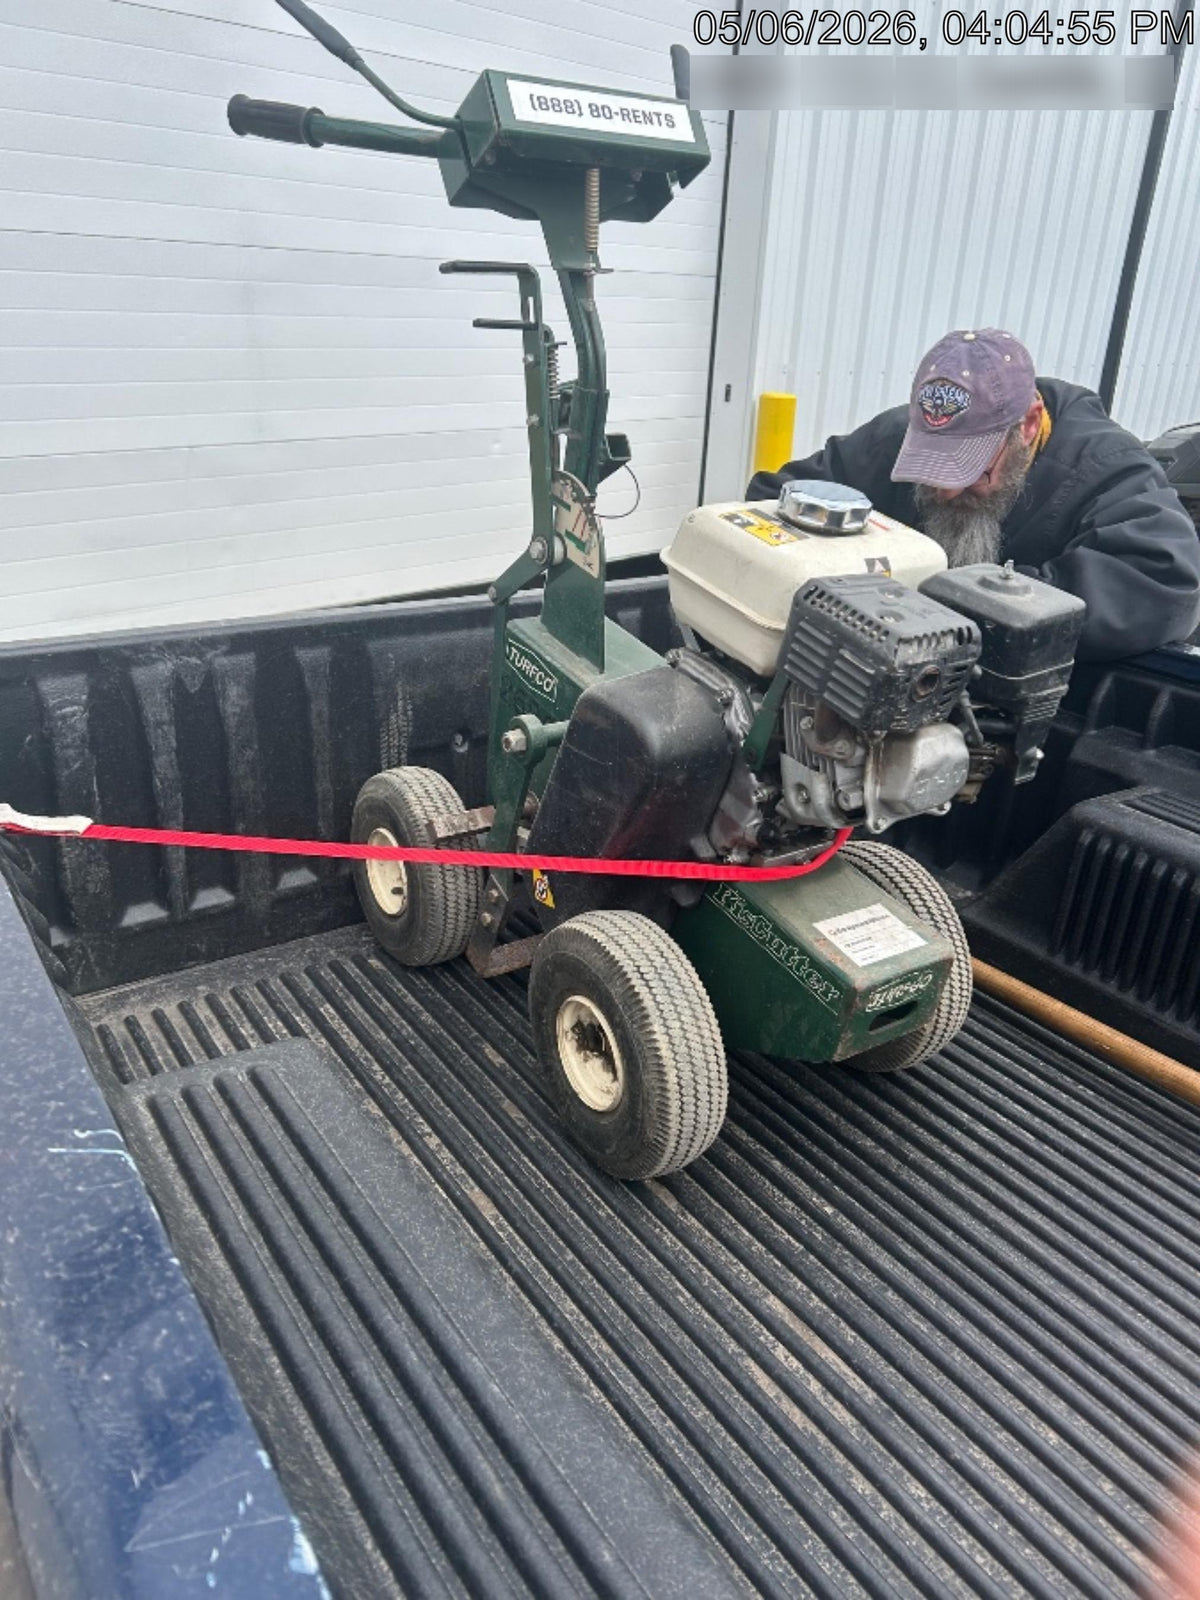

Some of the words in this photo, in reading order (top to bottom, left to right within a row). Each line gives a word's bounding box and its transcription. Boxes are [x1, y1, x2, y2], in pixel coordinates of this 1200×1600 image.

[528, 93, 583, 118] (888)
[588, 102, 676, 130] 80-RENTS
[509, 646, 554, 692] TURFCO
